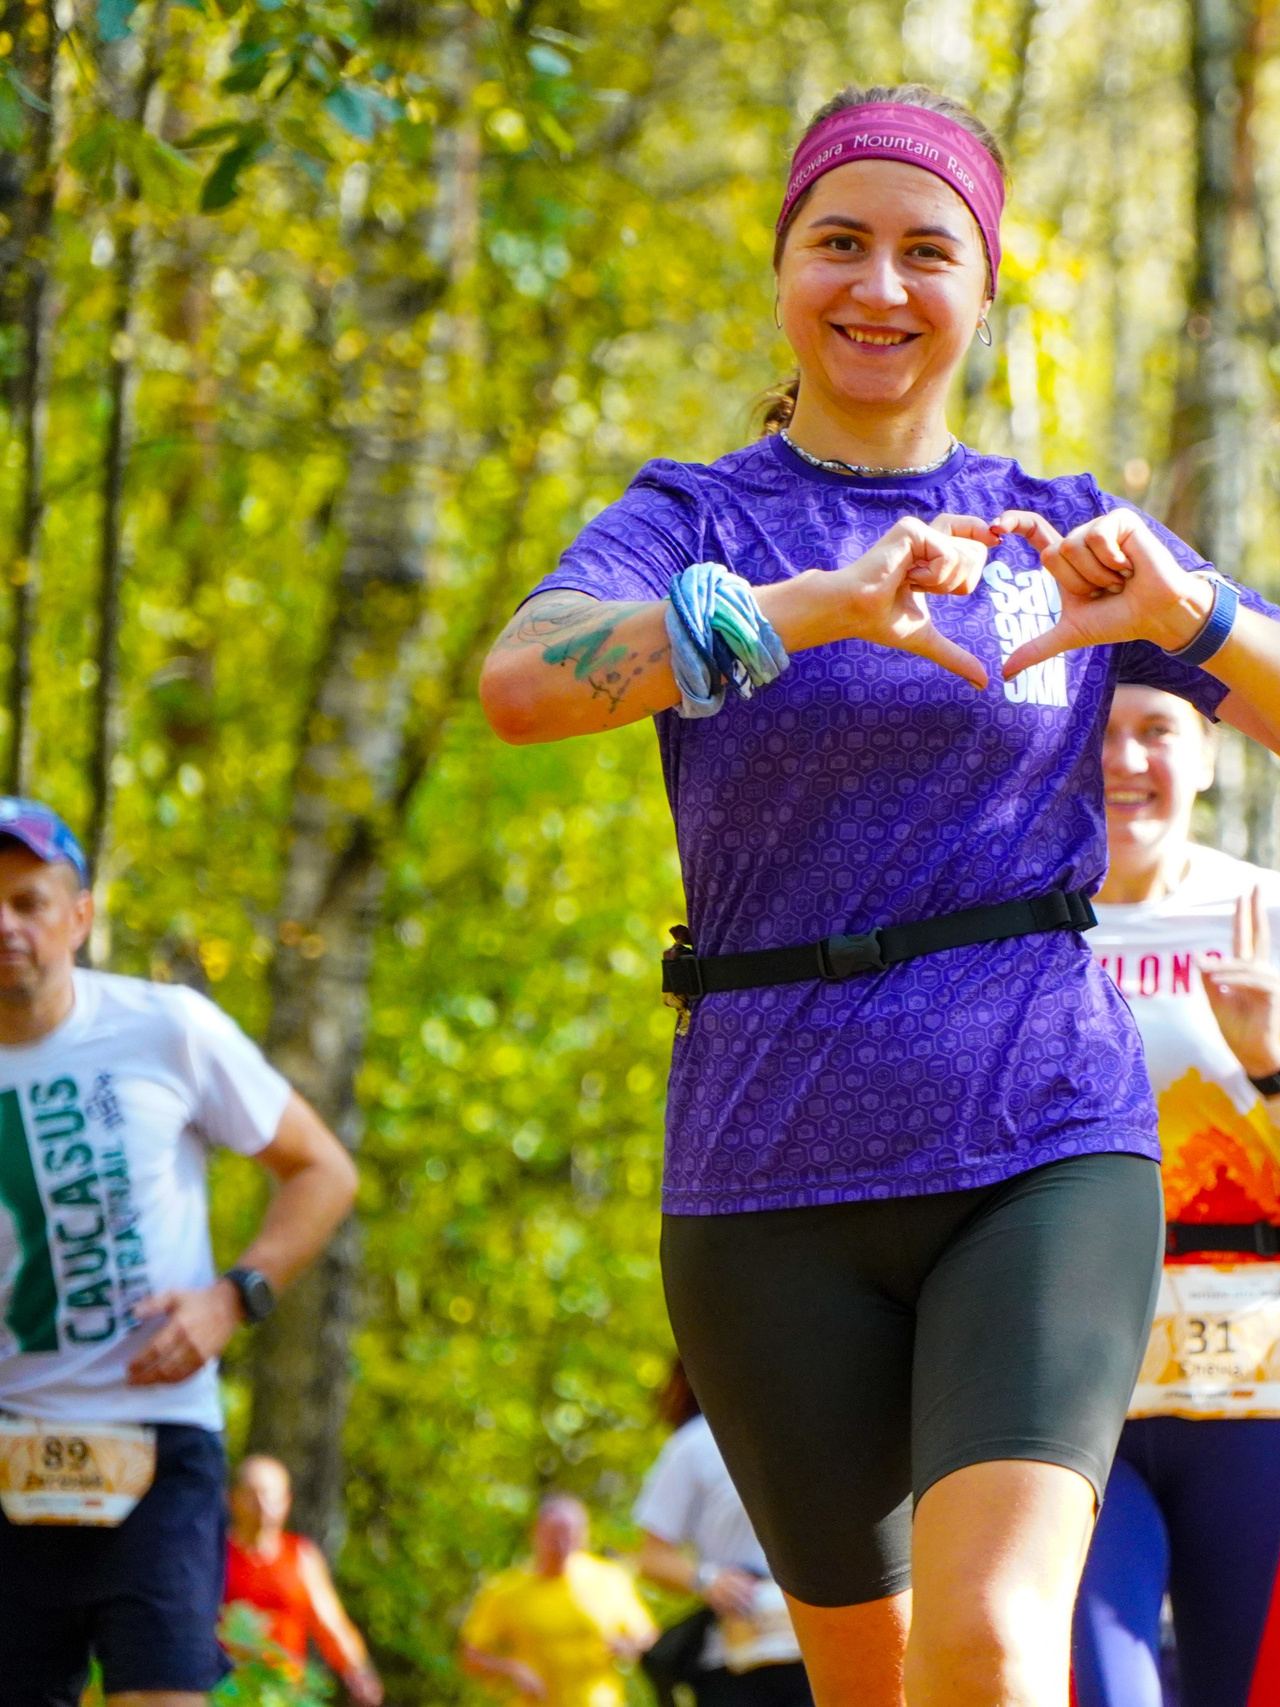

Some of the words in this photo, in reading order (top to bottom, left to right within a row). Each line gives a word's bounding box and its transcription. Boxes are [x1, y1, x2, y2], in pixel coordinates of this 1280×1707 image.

[852, 132, 940, 161] Mountain
[946, 155, 976, 194] Race
[1097, 951, 1222, 999] LON
[29, 1076, 117, 1344] CAUCASUS
[1187, 1318, 1235, 1355] 31
[43, 1436, 89, 1470] 89
